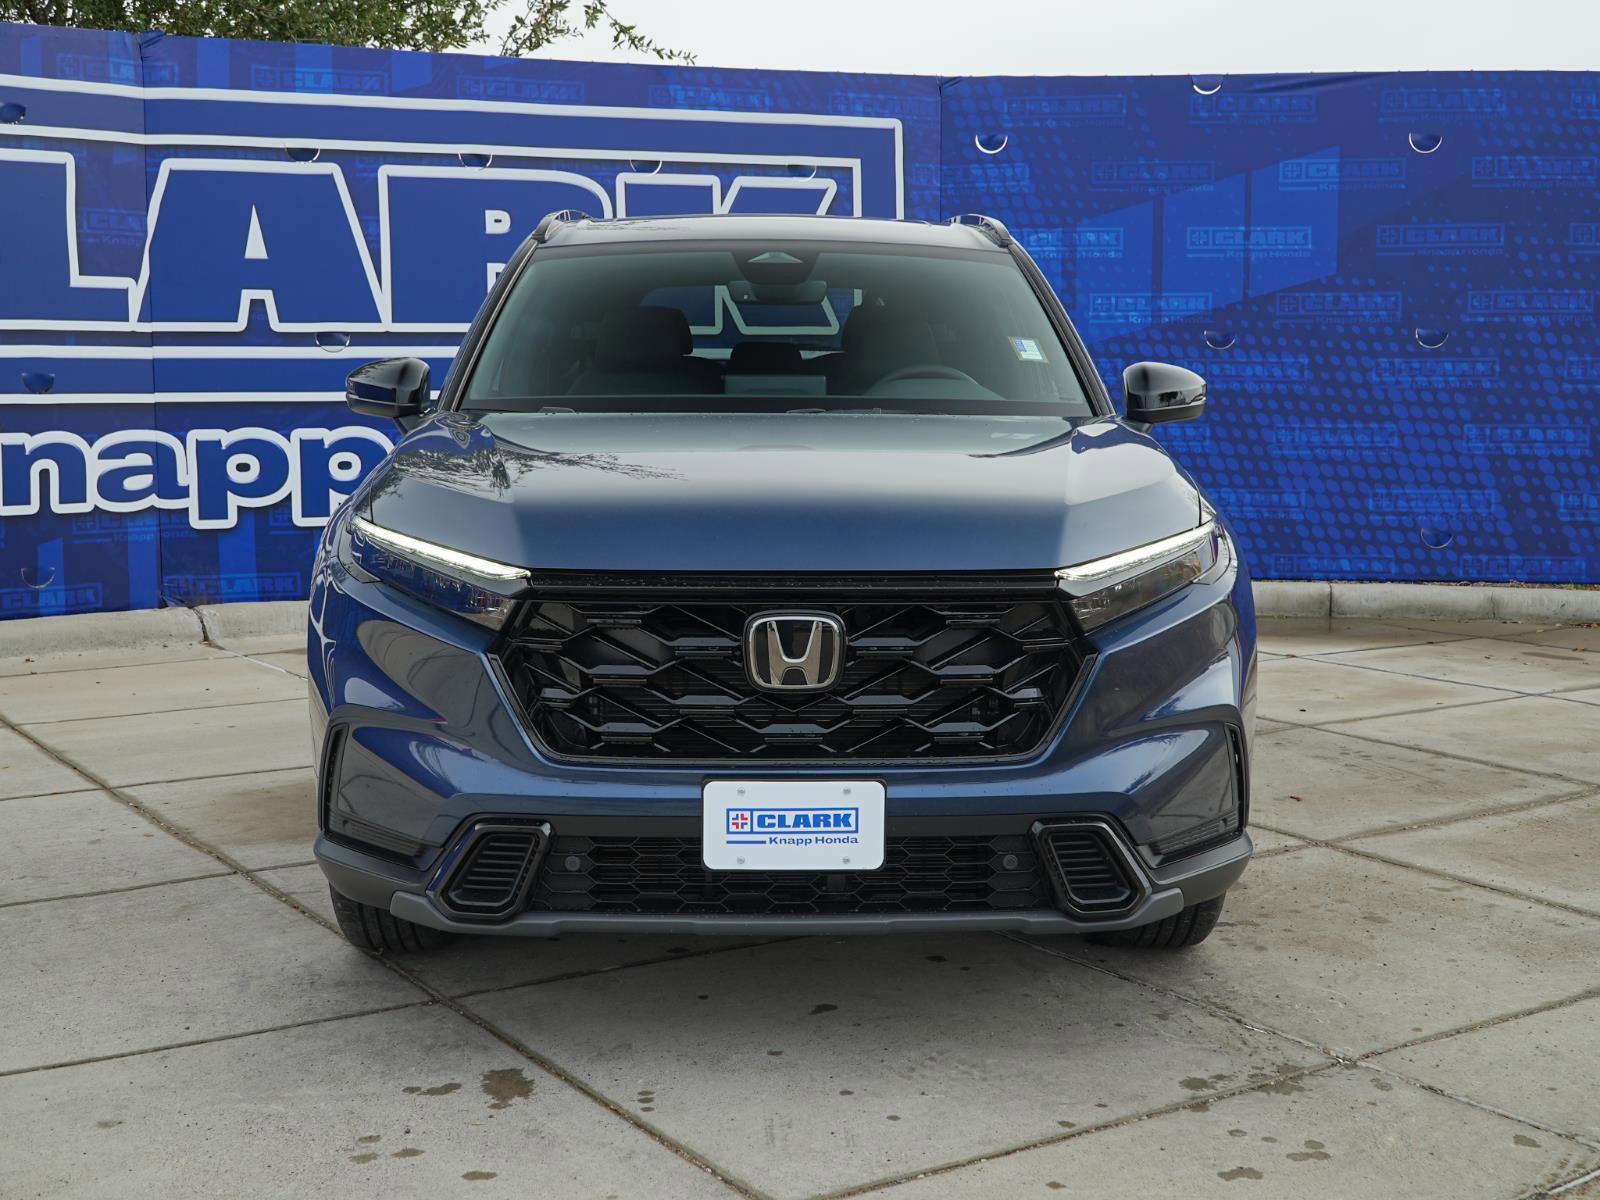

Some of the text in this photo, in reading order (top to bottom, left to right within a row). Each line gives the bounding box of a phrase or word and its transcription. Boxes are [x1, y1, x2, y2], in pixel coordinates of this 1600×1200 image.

[1214, 230, 1306, 245] CLARK
[756, 813, 853, 829] CLARK
[768, 835, 859, 846] Knapp Honda
